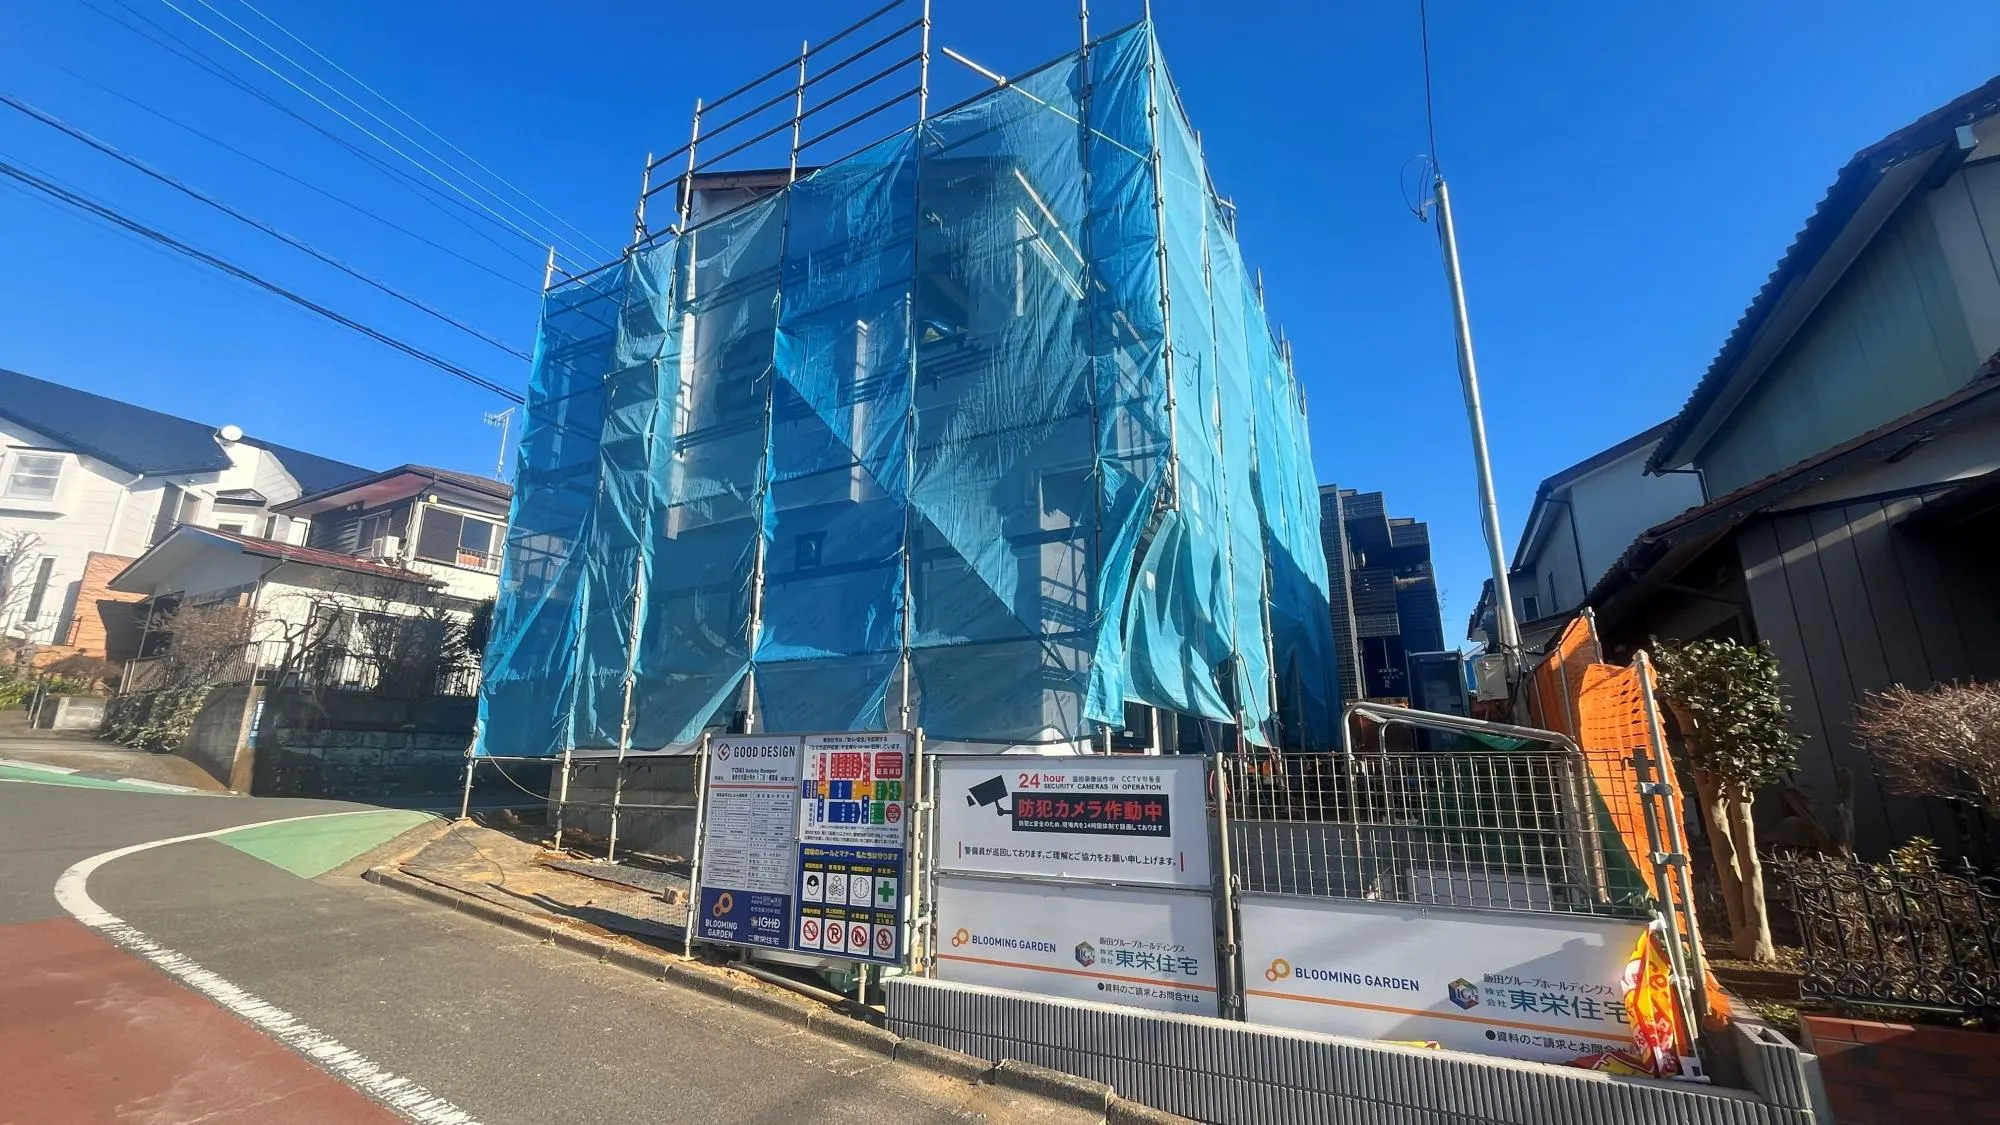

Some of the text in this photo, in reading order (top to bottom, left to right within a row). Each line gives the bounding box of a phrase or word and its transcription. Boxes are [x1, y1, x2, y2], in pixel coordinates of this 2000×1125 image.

[734, 746, 758, 757] GOOD
[761, 746, 795, 757] DESIGN
[1018, 773, 1065, 788] 24 hour
[1018, 799, 1162, 822] 防犯カメラ作動中
[705, 919, 737, 930] BLOOMING
[707, 929, 733, 939] GARDEN
[972, 935, 1056, 952] BLOOMING GARDEN
[1100, 937, 1185, 953] 飯田グループホールディングス
[1115, 949, 1198, 976] 東栄住宅
[1295, 967, 1420, 991] BLOOMING GARDEN
[1483, 973, 1615, 996] 飯田グループホールディングス
[1485, 988, 1506, 997] 株式
[1487, 999, 1507, 1008] 会社
[1508, 989, 1631, 1025] 東栄住宅
